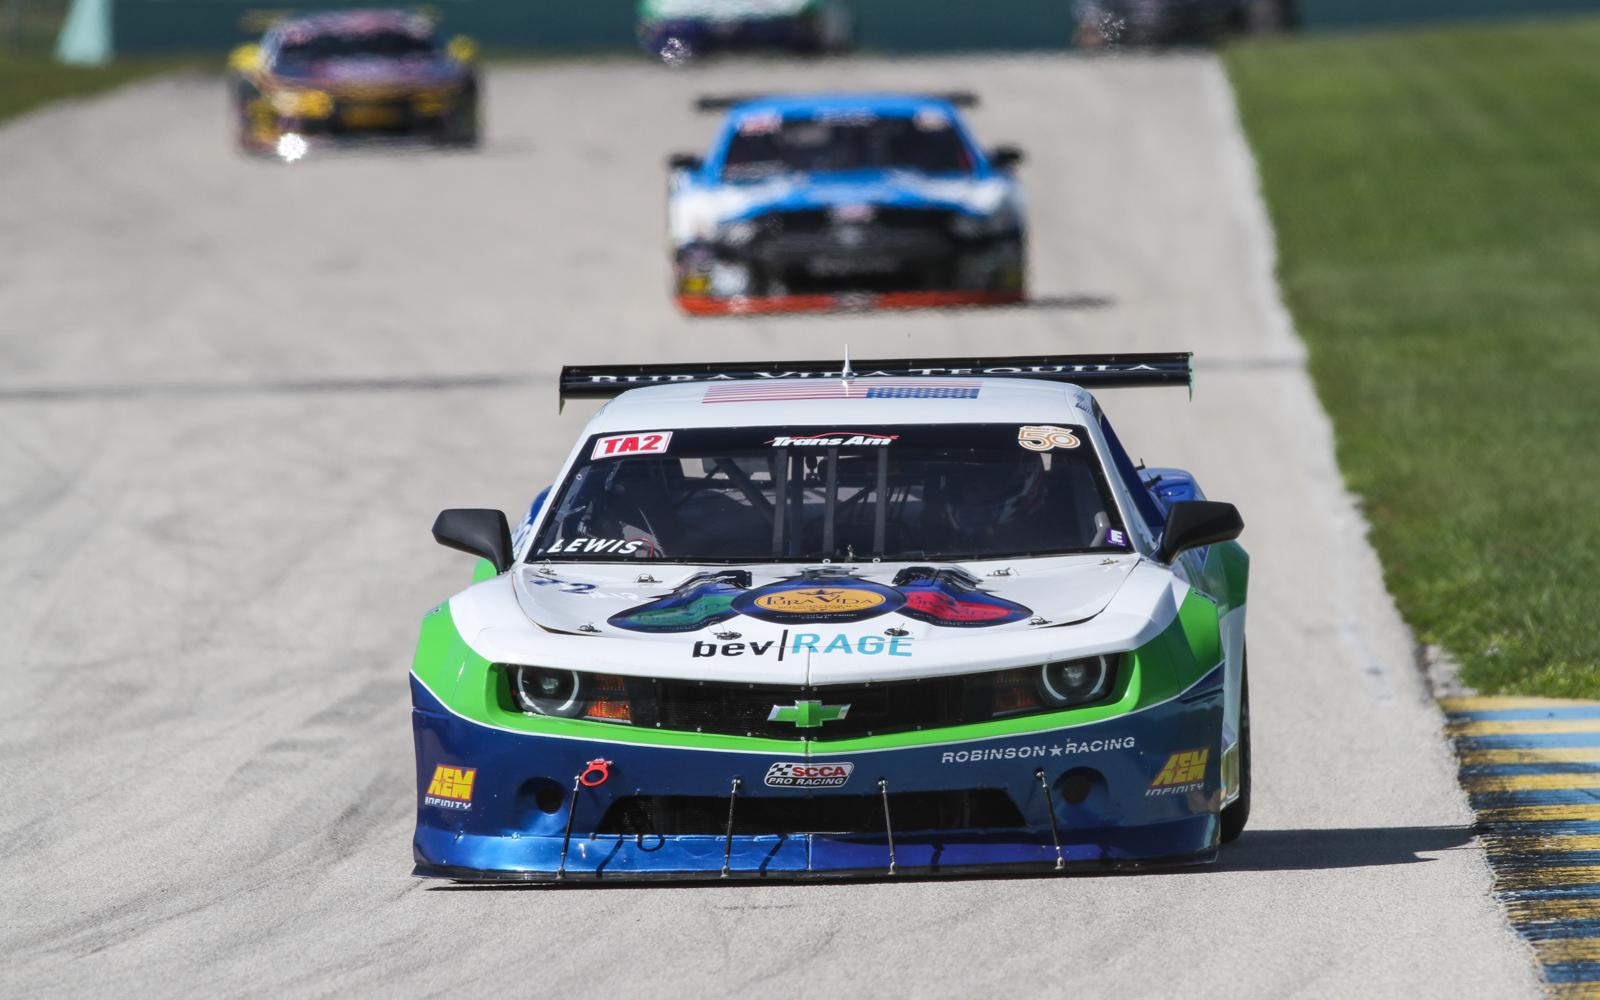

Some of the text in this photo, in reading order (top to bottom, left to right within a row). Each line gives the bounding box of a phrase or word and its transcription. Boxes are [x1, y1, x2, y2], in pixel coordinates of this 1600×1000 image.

[603, 434, 660, 455] TA2
[772, 436, 892, 447] Trans Am
[1018, 429, 1081, 451] 50
[547, 538, 644, 554] LEWIS
[941, 736, 1136, 763] ROBINSON RACING
[791, 766, 847, 777] SCCA
[768, 777, 845, 786] PRO RACING
